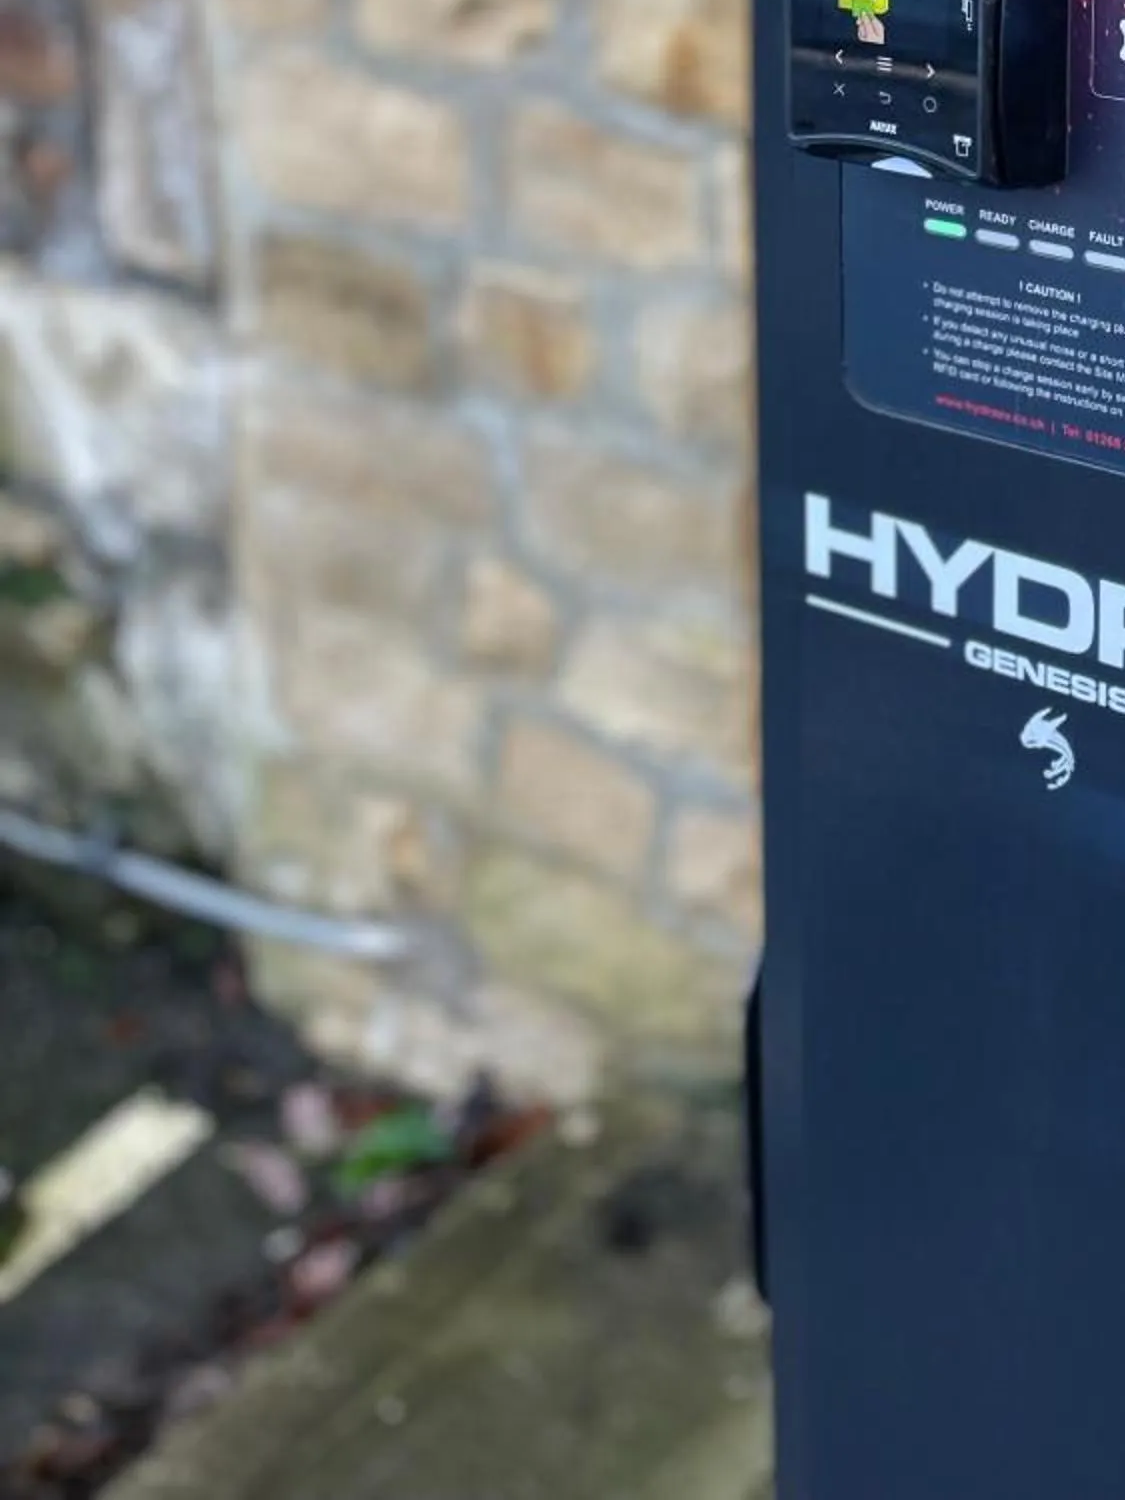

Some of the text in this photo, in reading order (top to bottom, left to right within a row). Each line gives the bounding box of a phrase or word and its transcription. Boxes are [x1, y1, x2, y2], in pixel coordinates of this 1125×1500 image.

[924, 198, 965, 215] POWER
[979, 208, 1017, 226] READY
[1027, 219, 1076, 239] CHARGE
[1088, 230, 1124, 247] FAULT
[932, 280, 947, 296] Do
[1002, 297, 1013, 309] to
[1013, 301, 1050, 317] remove
[1051, 308, 1068, 322] the
[1069, 313, 1112, 334] charging
[1025, 282, 1075, 303] CAUTION
[933, 297, 973, 317] charging
[1012, 314, 1021, 325] is
[1021, 316, 1051, 335] taking
[1052, 322, 1079, 339] place
[932, 329, 962, 347] during
[971, 339, 1004, 356] charge
[1005, 347, 1037, 363] please
[1039, 355, 1075, 372] contact
[1075, 362, 1092, 376] the
[1094, 365, 1114, 381] Site
[960, 322, 989, 338] detect
[990, 330, 1008, 345] any
[1009, 333, 1047, 351] unusual
[1049, 342, 1075, 357] noise
[1077, 349, 1088, 360] or
[1089, 352, 1097, 363] a
[1099, 354, 1125, 369] short
[959, 369, 980, 382] card
[980, 374, 992, 385] or
[992, 376, 1035, 398] following
[1053, 393, 1109, 414] instructions
[1109, 405, 1123, 418] on
[1001, 365, 1035, 383] charge
[1075, 383, 1099, 400] early
[1101, 387, 1113, 403] by
